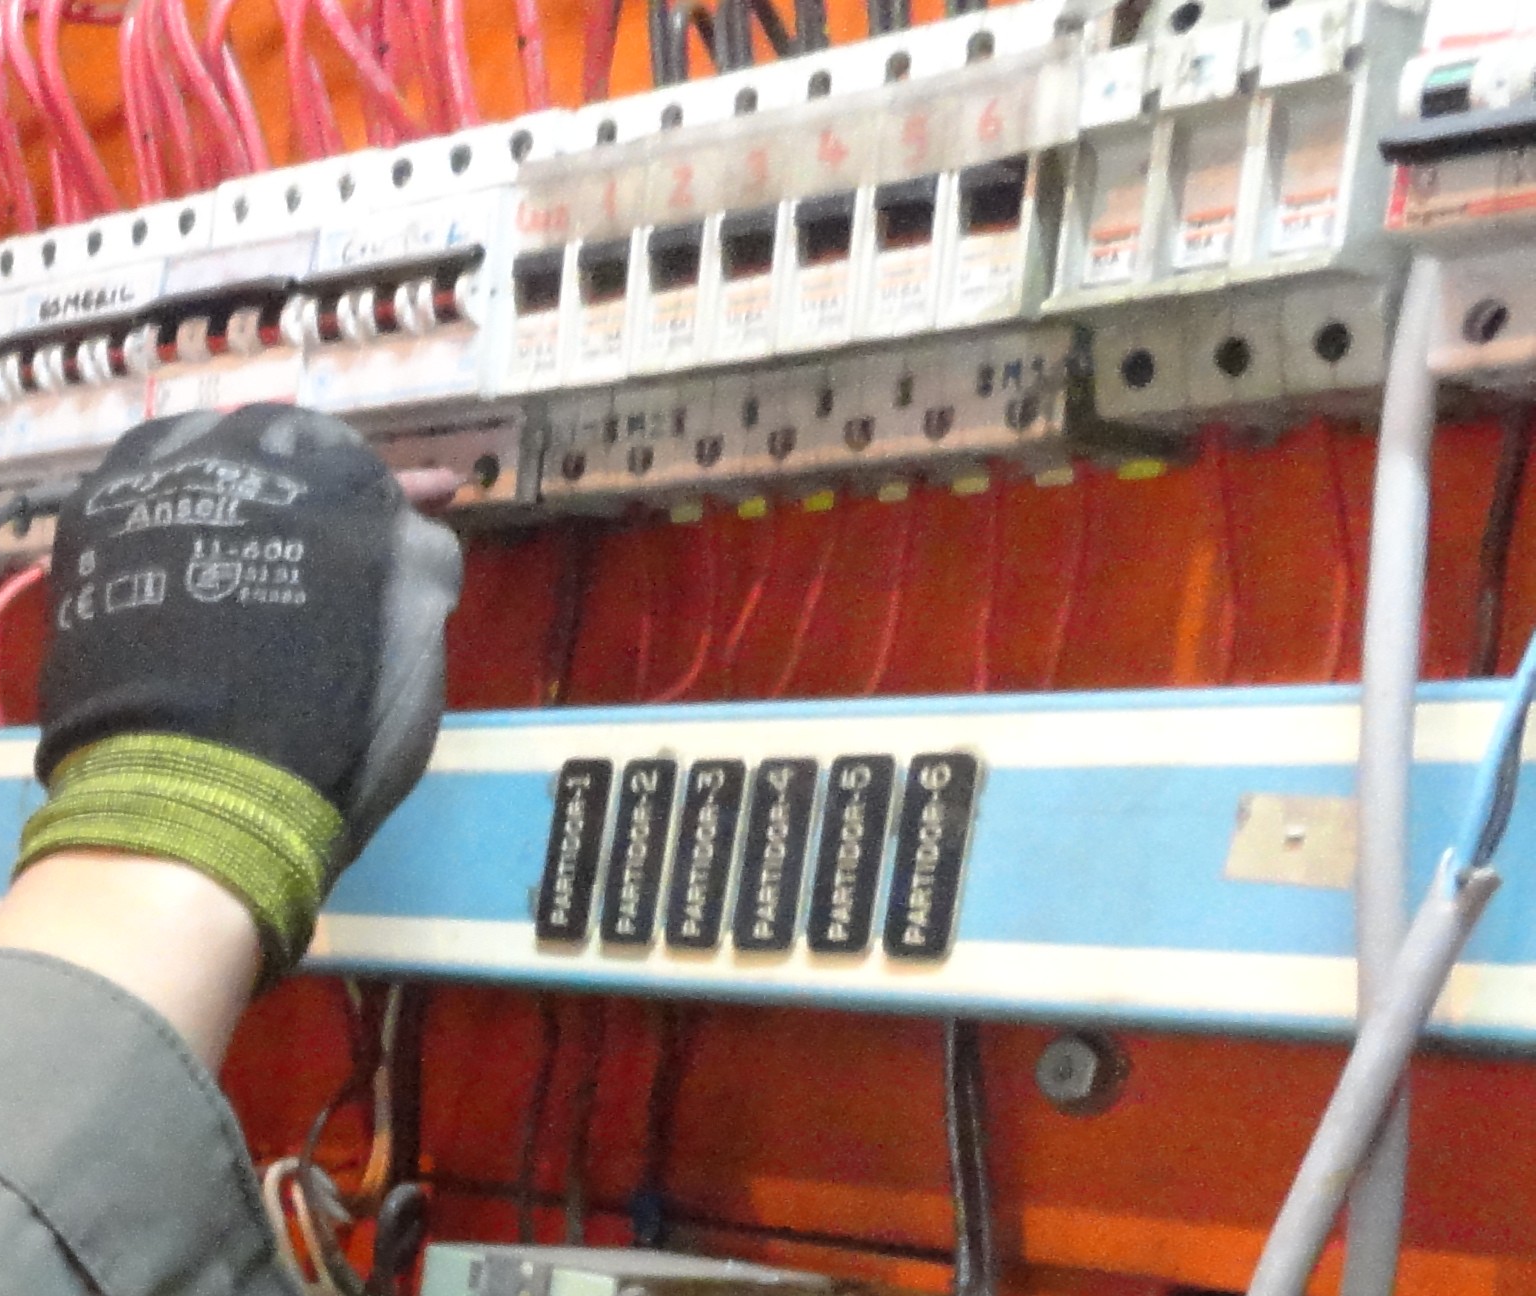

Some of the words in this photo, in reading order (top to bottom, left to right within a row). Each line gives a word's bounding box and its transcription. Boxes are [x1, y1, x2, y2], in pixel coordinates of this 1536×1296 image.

[668, 163, 695, 209] 2
[817, 127, 850, 173] 4
[977, 99, 1004, 142] 6
[126, 496, 240, 530] Ansell
[193, 537, 305, 562] 11-600
[549, 770, 591, 926] PARTIDOR-1
[615, 767, 658, 936] PARTIDOR-2
[680, 767, 724, 939] PARTIDOR-3
[751, 765, 794, 940] PARTIDOR-4
[826, 763, 872, 943] PARTIDOR-5
[902, 762, 952, 948] PARTIDOR-6
